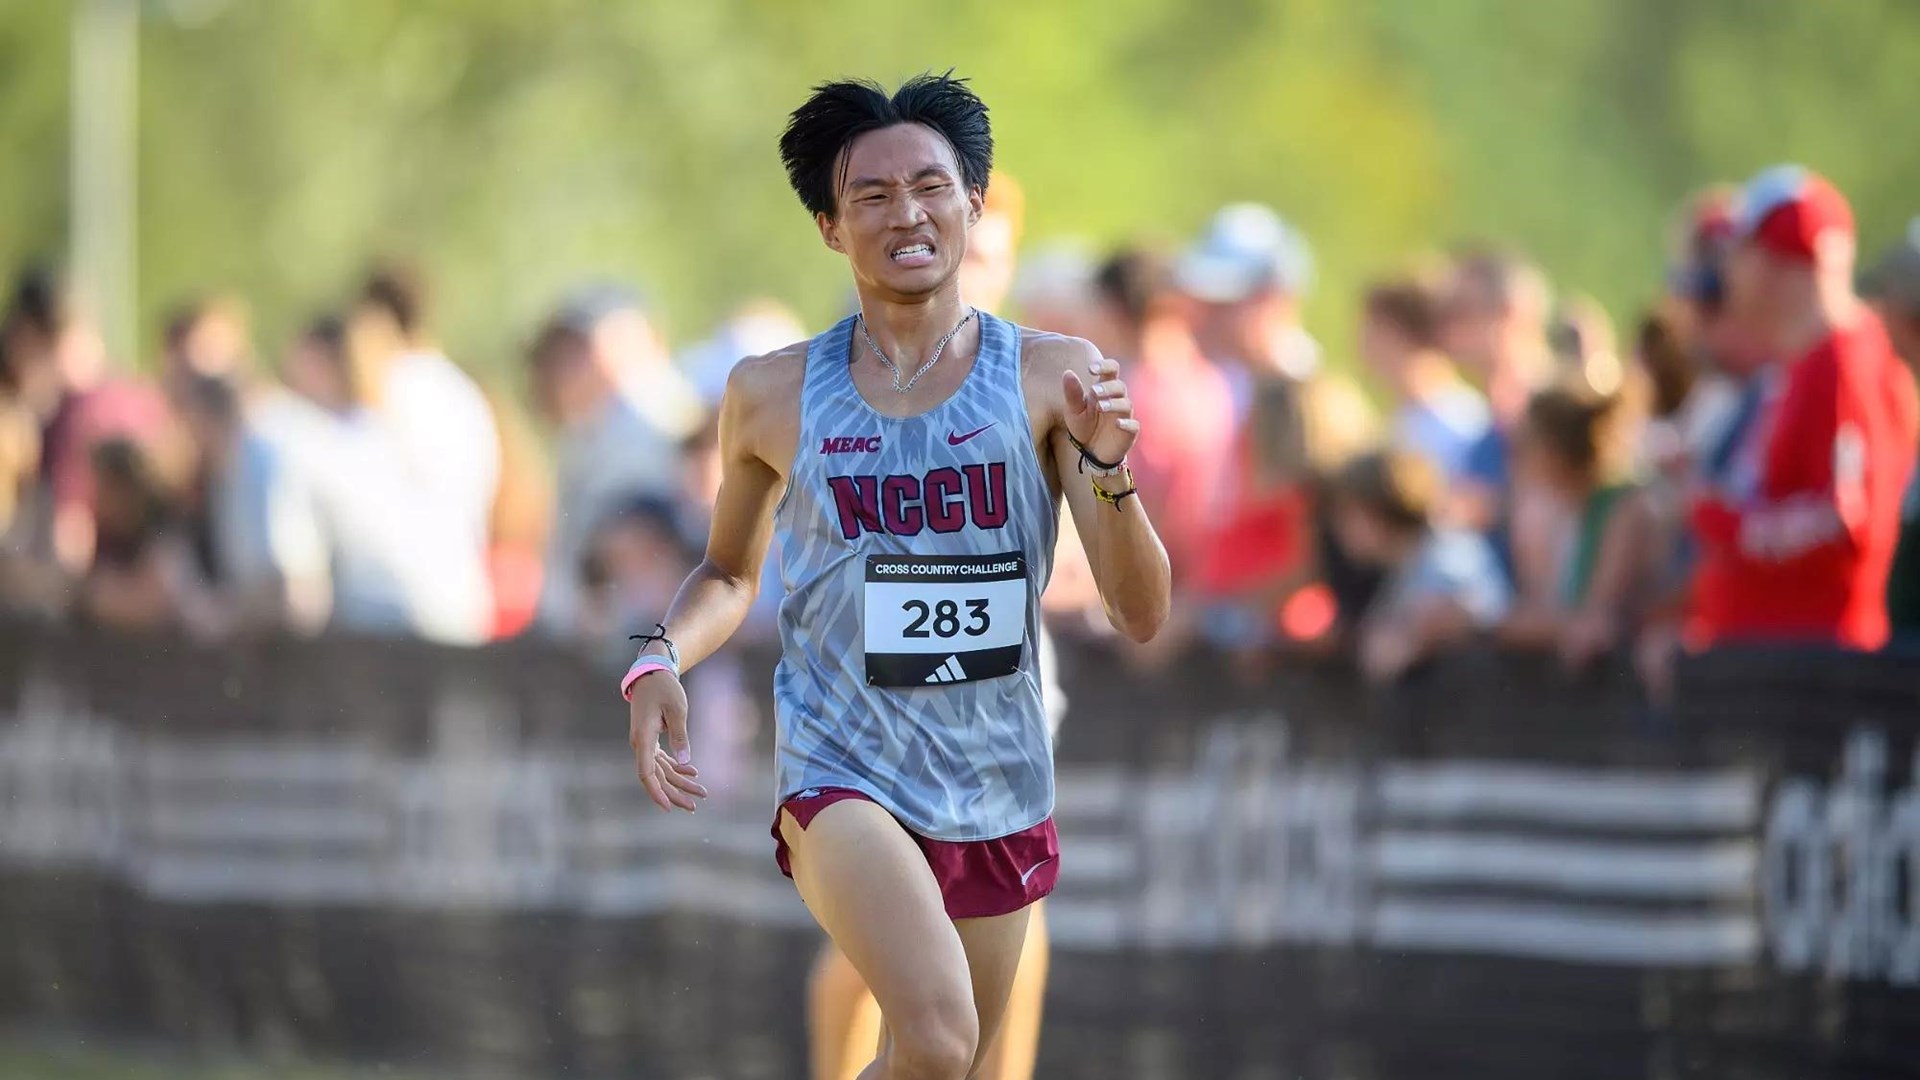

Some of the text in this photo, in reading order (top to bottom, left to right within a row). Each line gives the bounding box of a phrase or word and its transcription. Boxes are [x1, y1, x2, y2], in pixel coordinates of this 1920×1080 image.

[820, 436, 882, 455] MEAC
[827, 462, 1009, 540] NCCU
[875, 561, 1018, 575] CROSS COUNTRY CHALLENGE
[902, 599, 991, 638] 283
